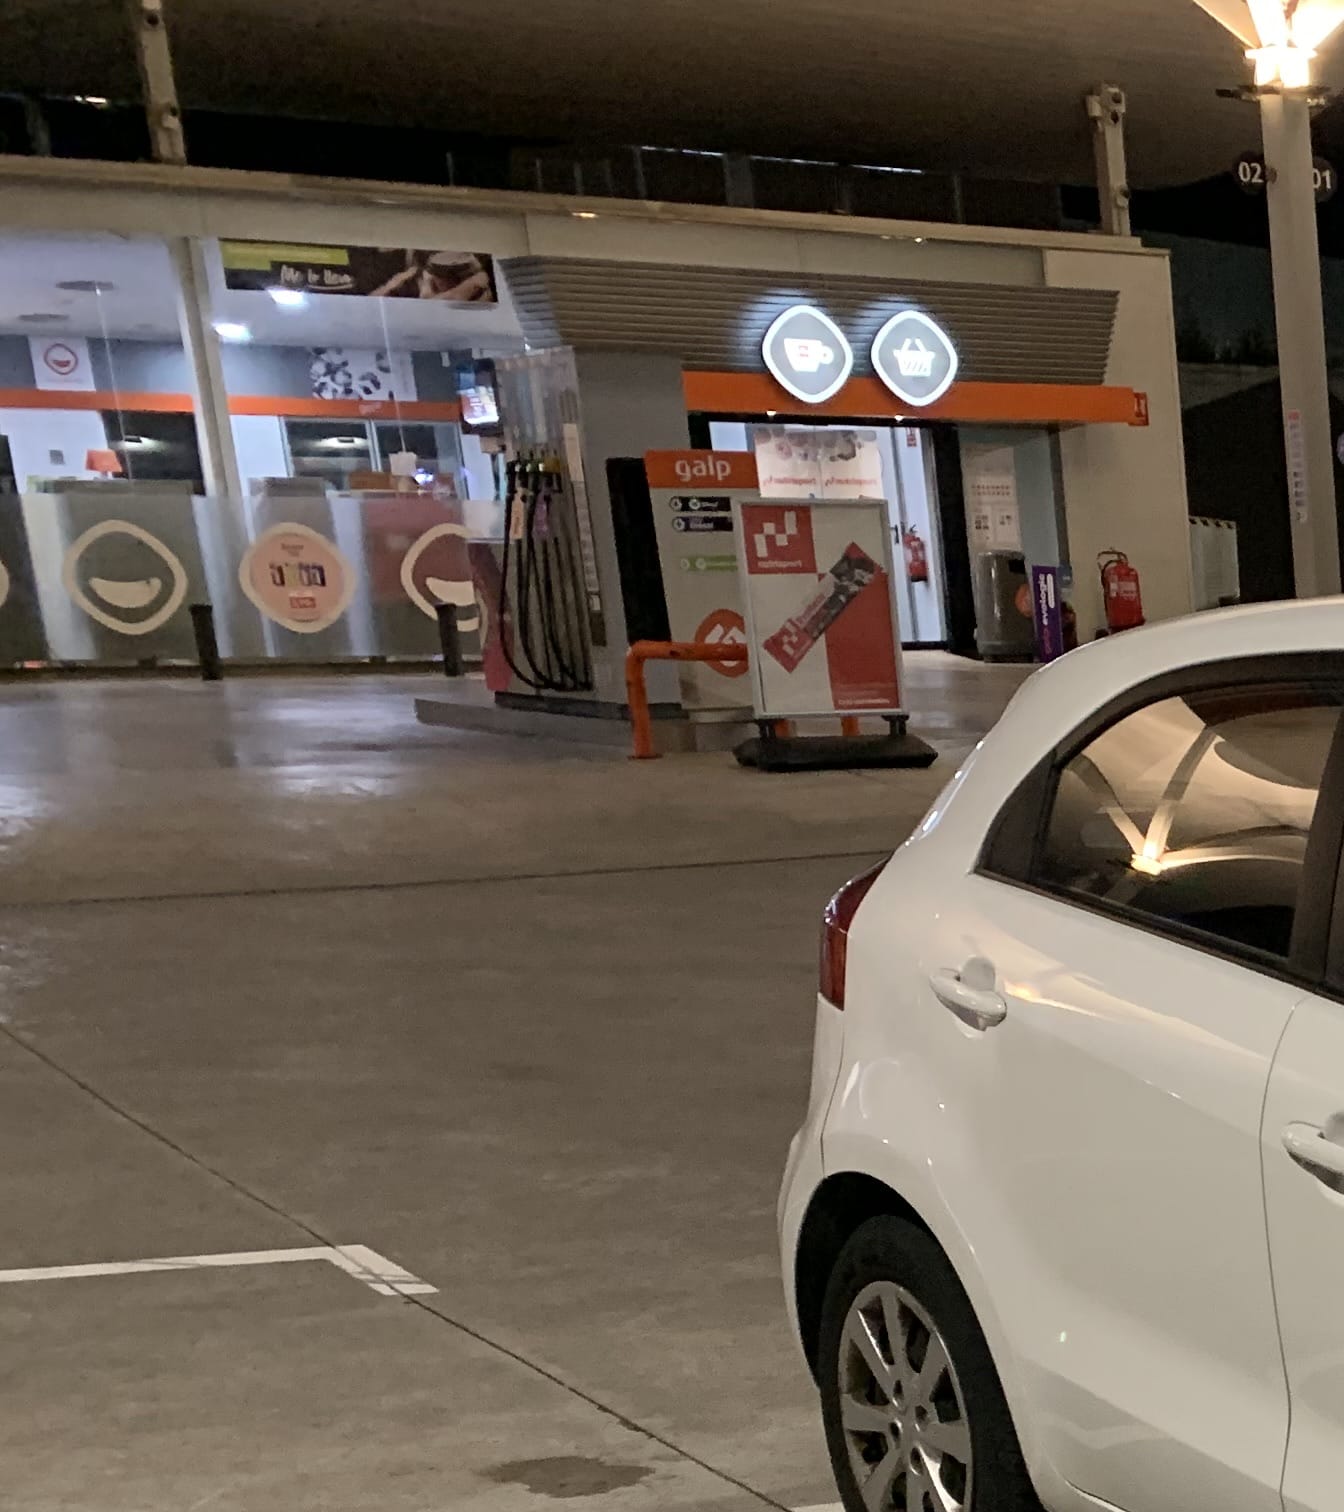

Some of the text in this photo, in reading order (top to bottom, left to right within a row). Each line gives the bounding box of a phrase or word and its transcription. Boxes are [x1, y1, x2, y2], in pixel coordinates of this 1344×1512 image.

[1238, 161, 1265, 183] 02
[1312, 167, 1332, 189] 01
[674, 455, 732, 481] galp
